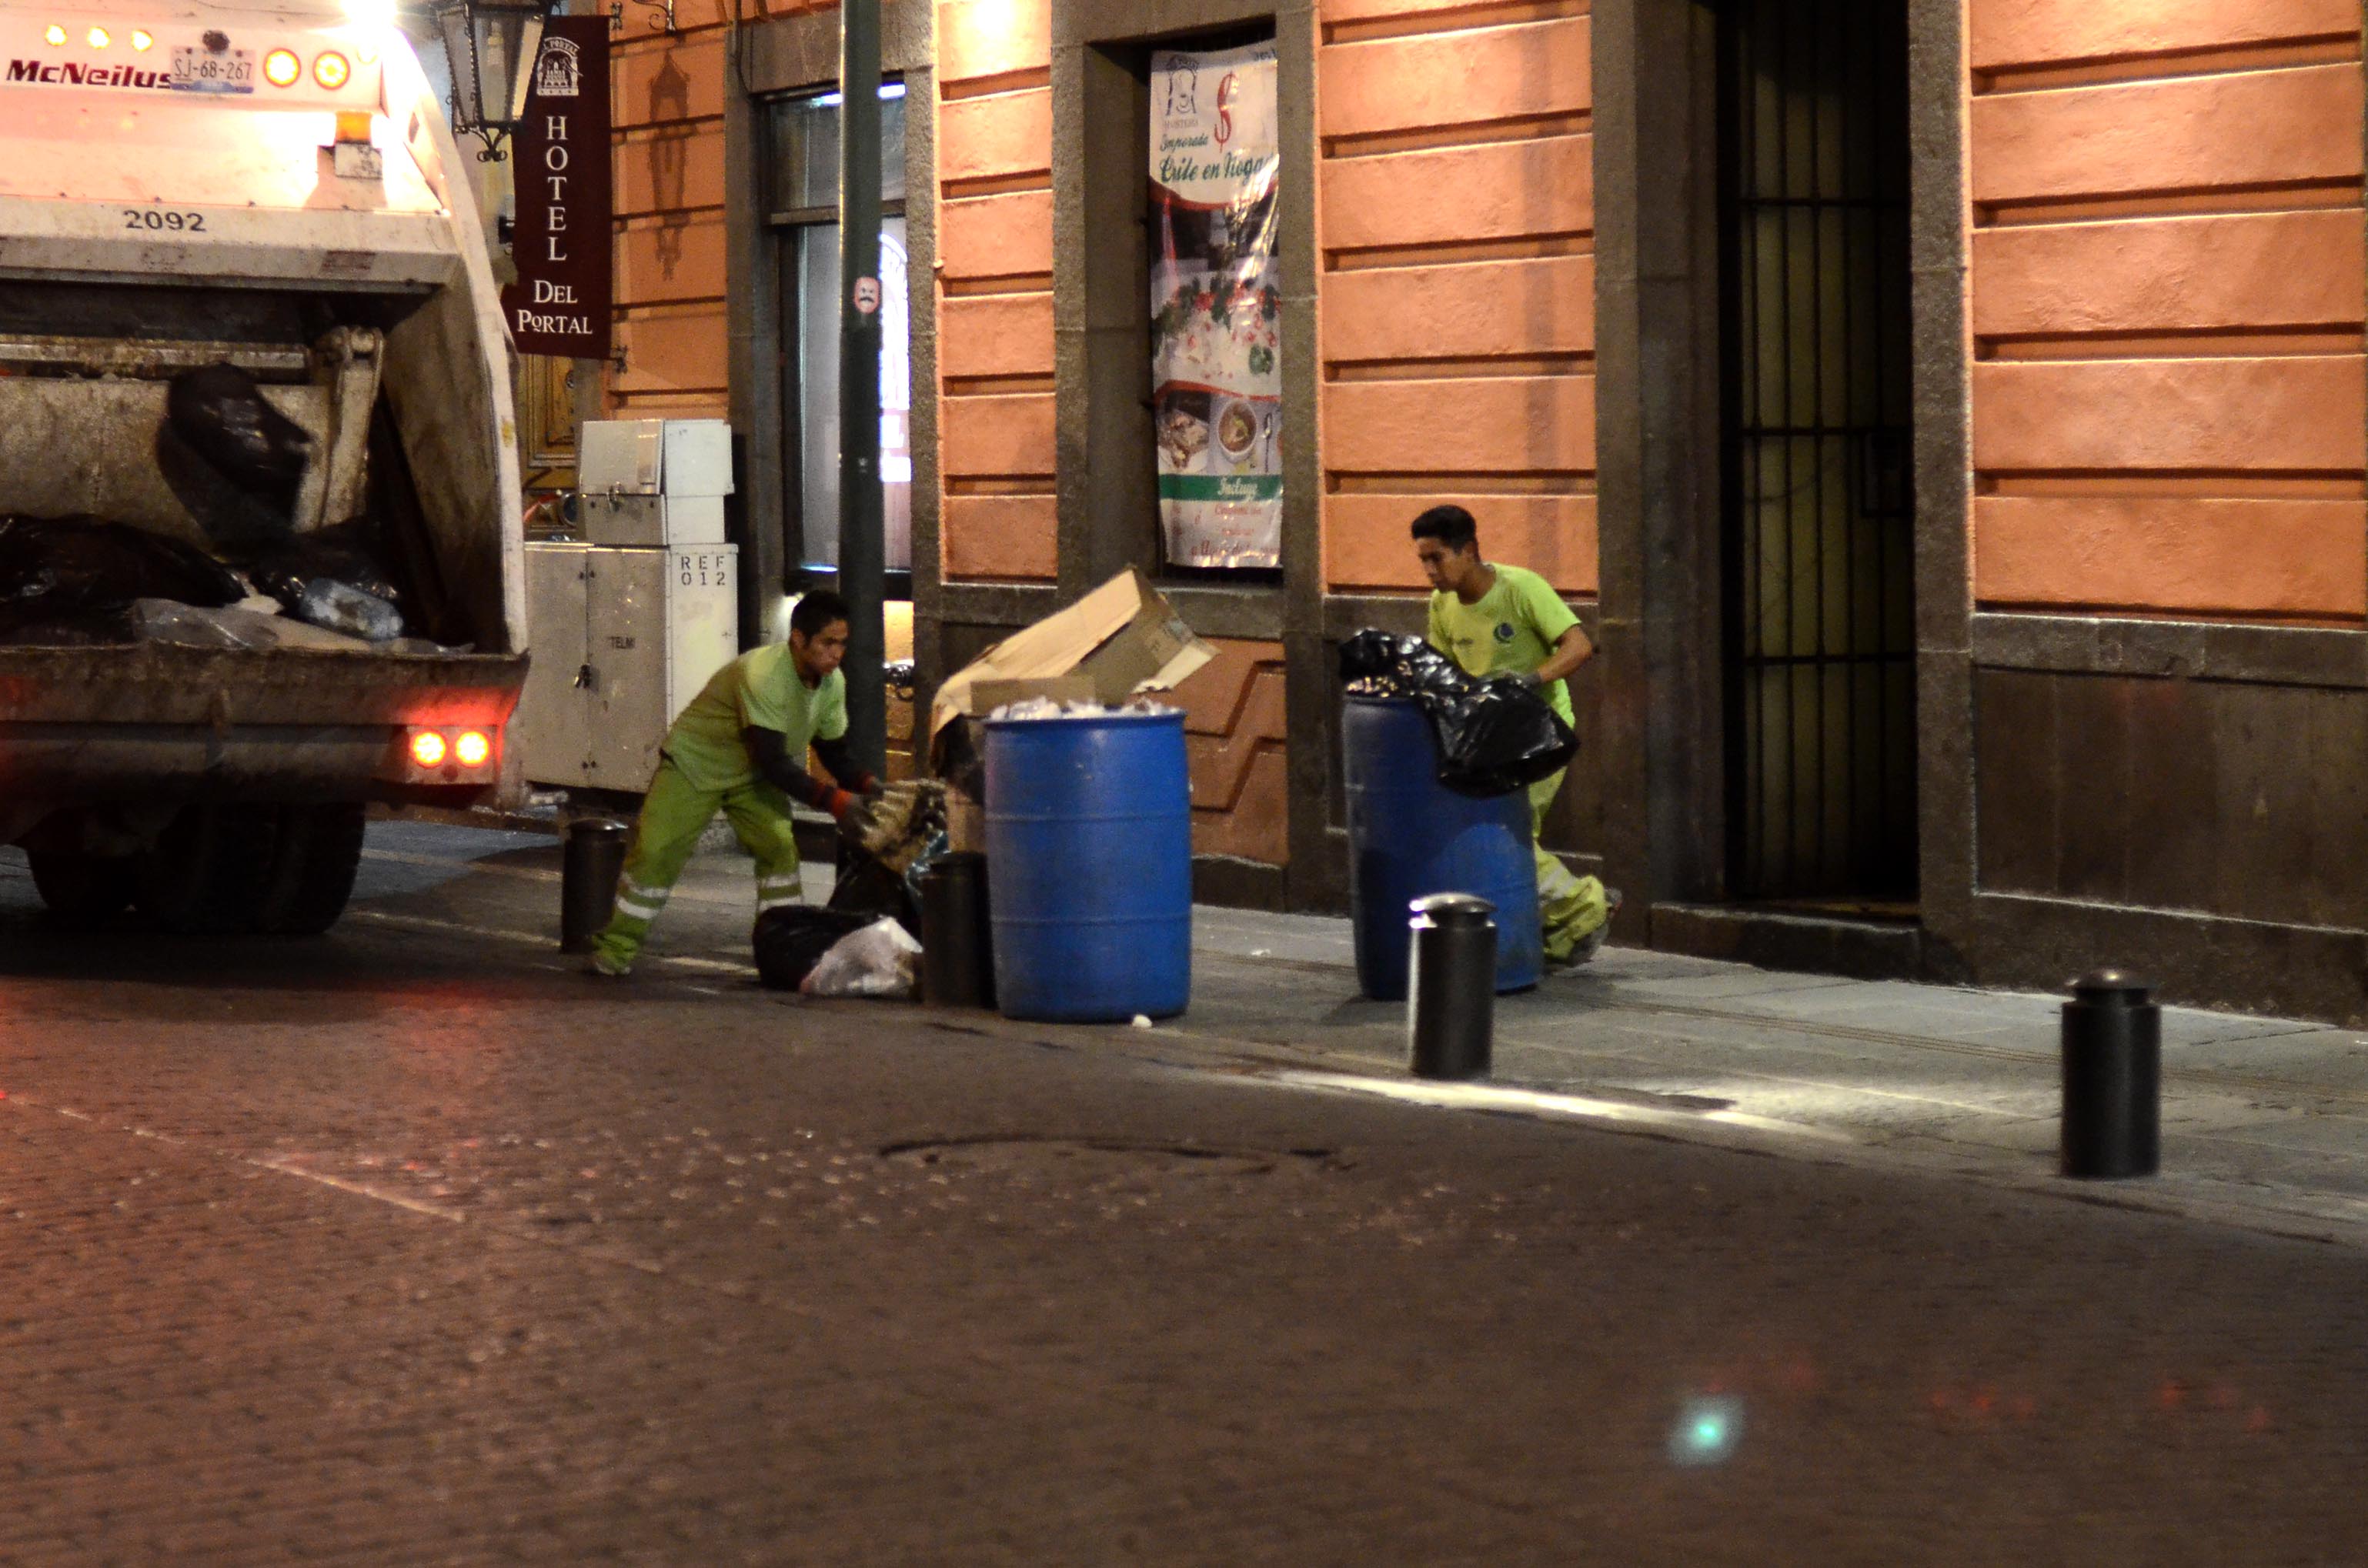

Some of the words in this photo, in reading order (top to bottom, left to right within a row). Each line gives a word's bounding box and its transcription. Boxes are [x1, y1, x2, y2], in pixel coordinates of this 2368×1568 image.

[6, 58, 171, 89] McNeilus
[174, 58, 252, 80] SJ-68-267
[1203, 160, 1221, 180] en
[546, 115, 569, 262] HOTEL
[123, 209, 207, 232] 2092
[533, 279, 579, 304] DEL
[517, 309, 593, 335] PORTAL
[681, 555, 725, 570] REF
[681, 572, 726, 586] 012
